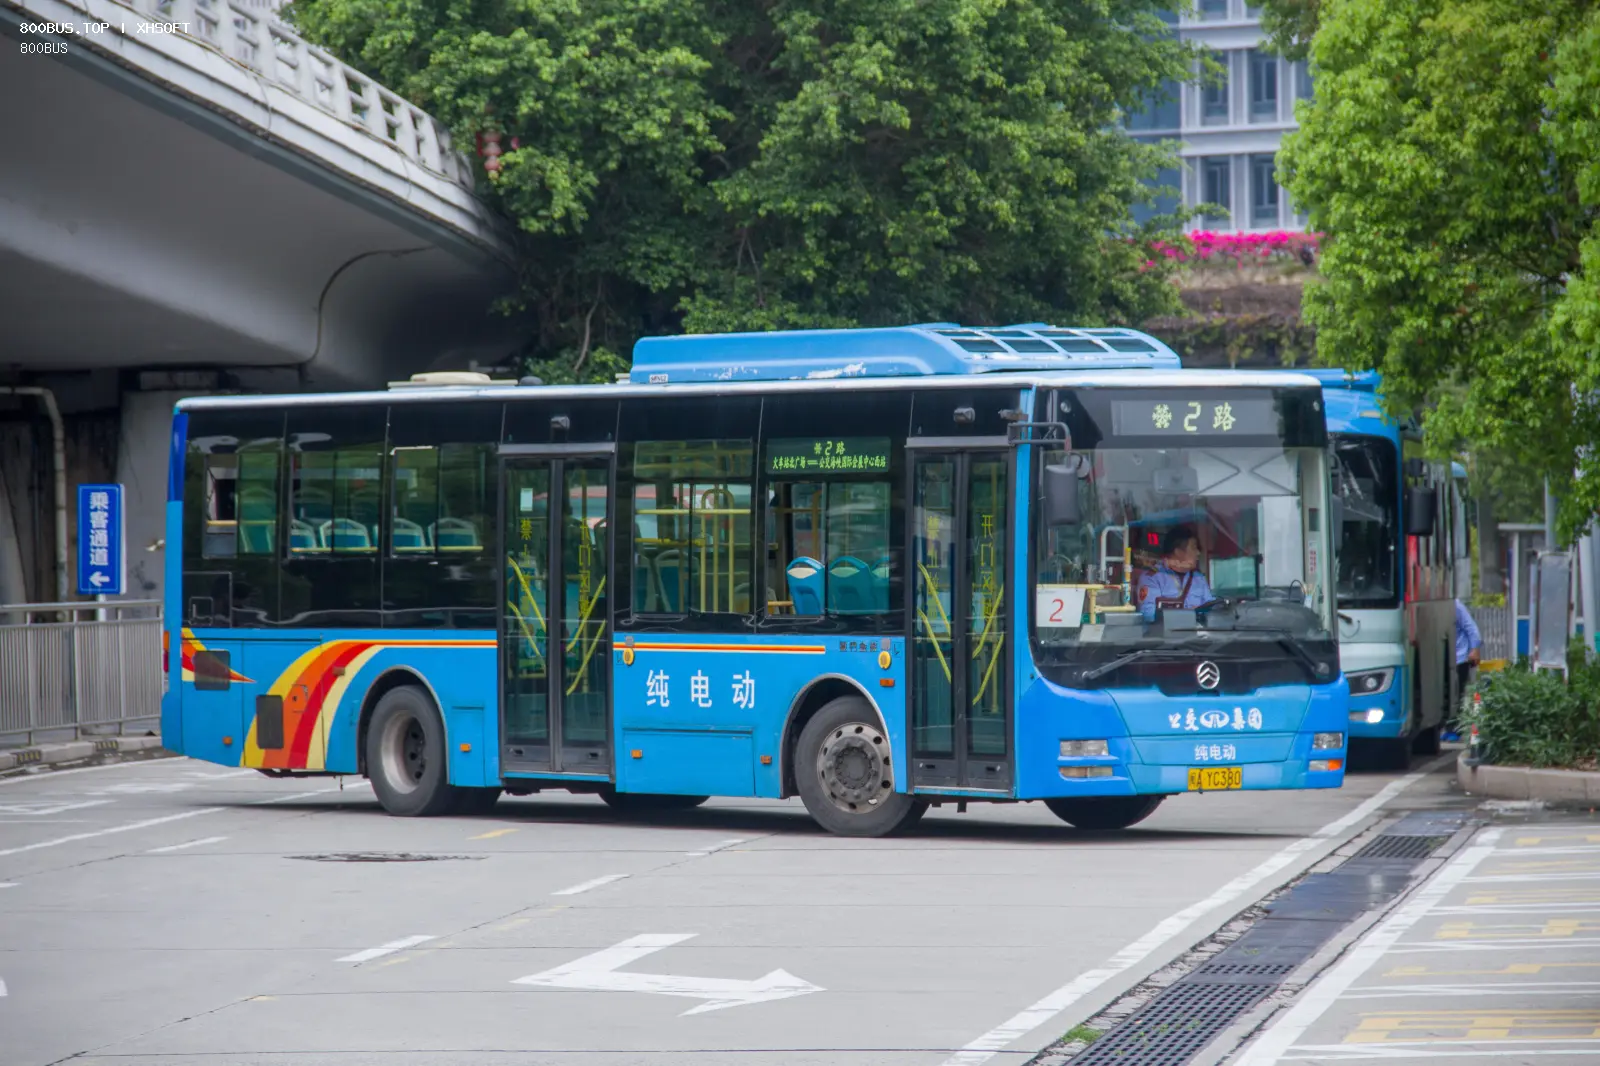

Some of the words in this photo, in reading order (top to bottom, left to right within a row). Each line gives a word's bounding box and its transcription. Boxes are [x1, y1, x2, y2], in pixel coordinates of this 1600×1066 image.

[90, 492, 109, 566] 乘客通道
[1049, 598, 1064, 622] 2
[646, 669, 755, 709] 纯电动
[1195, 744, 1236, 760] 纯电动
